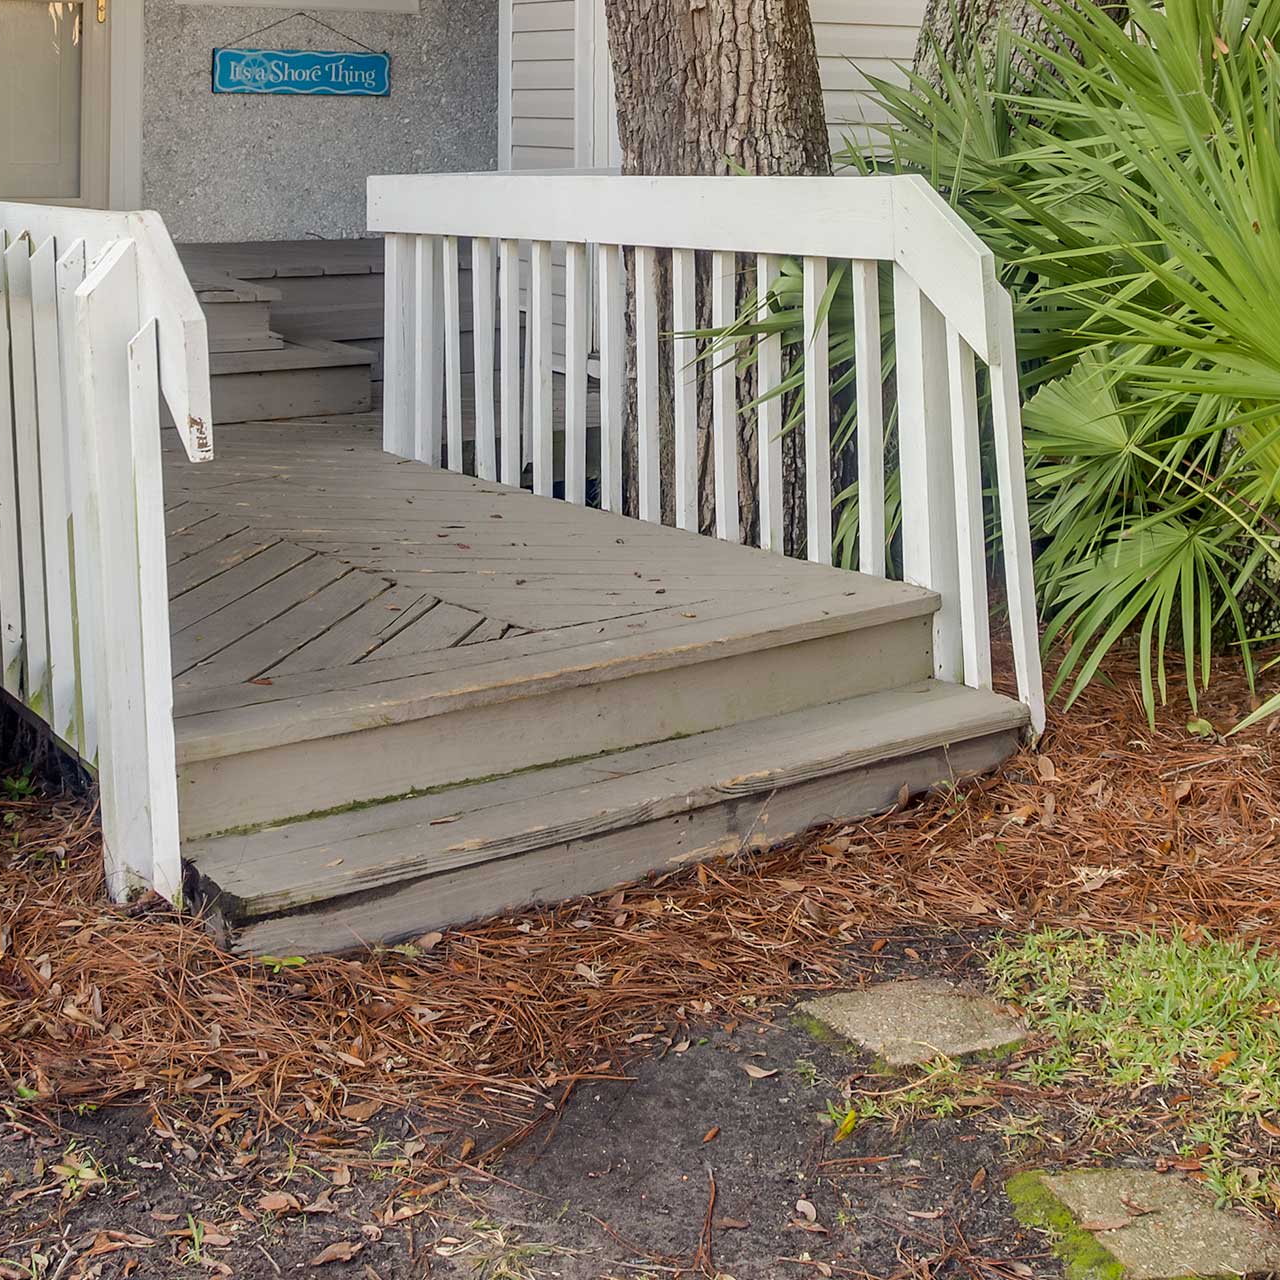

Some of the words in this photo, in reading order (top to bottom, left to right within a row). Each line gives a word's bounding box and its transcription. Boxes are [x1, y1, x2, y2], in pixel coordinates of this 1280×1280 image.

[255, 67, 265, 80] a
[270, 60, 321, 83] Shore
[325, 58, 376, 88] Thing
